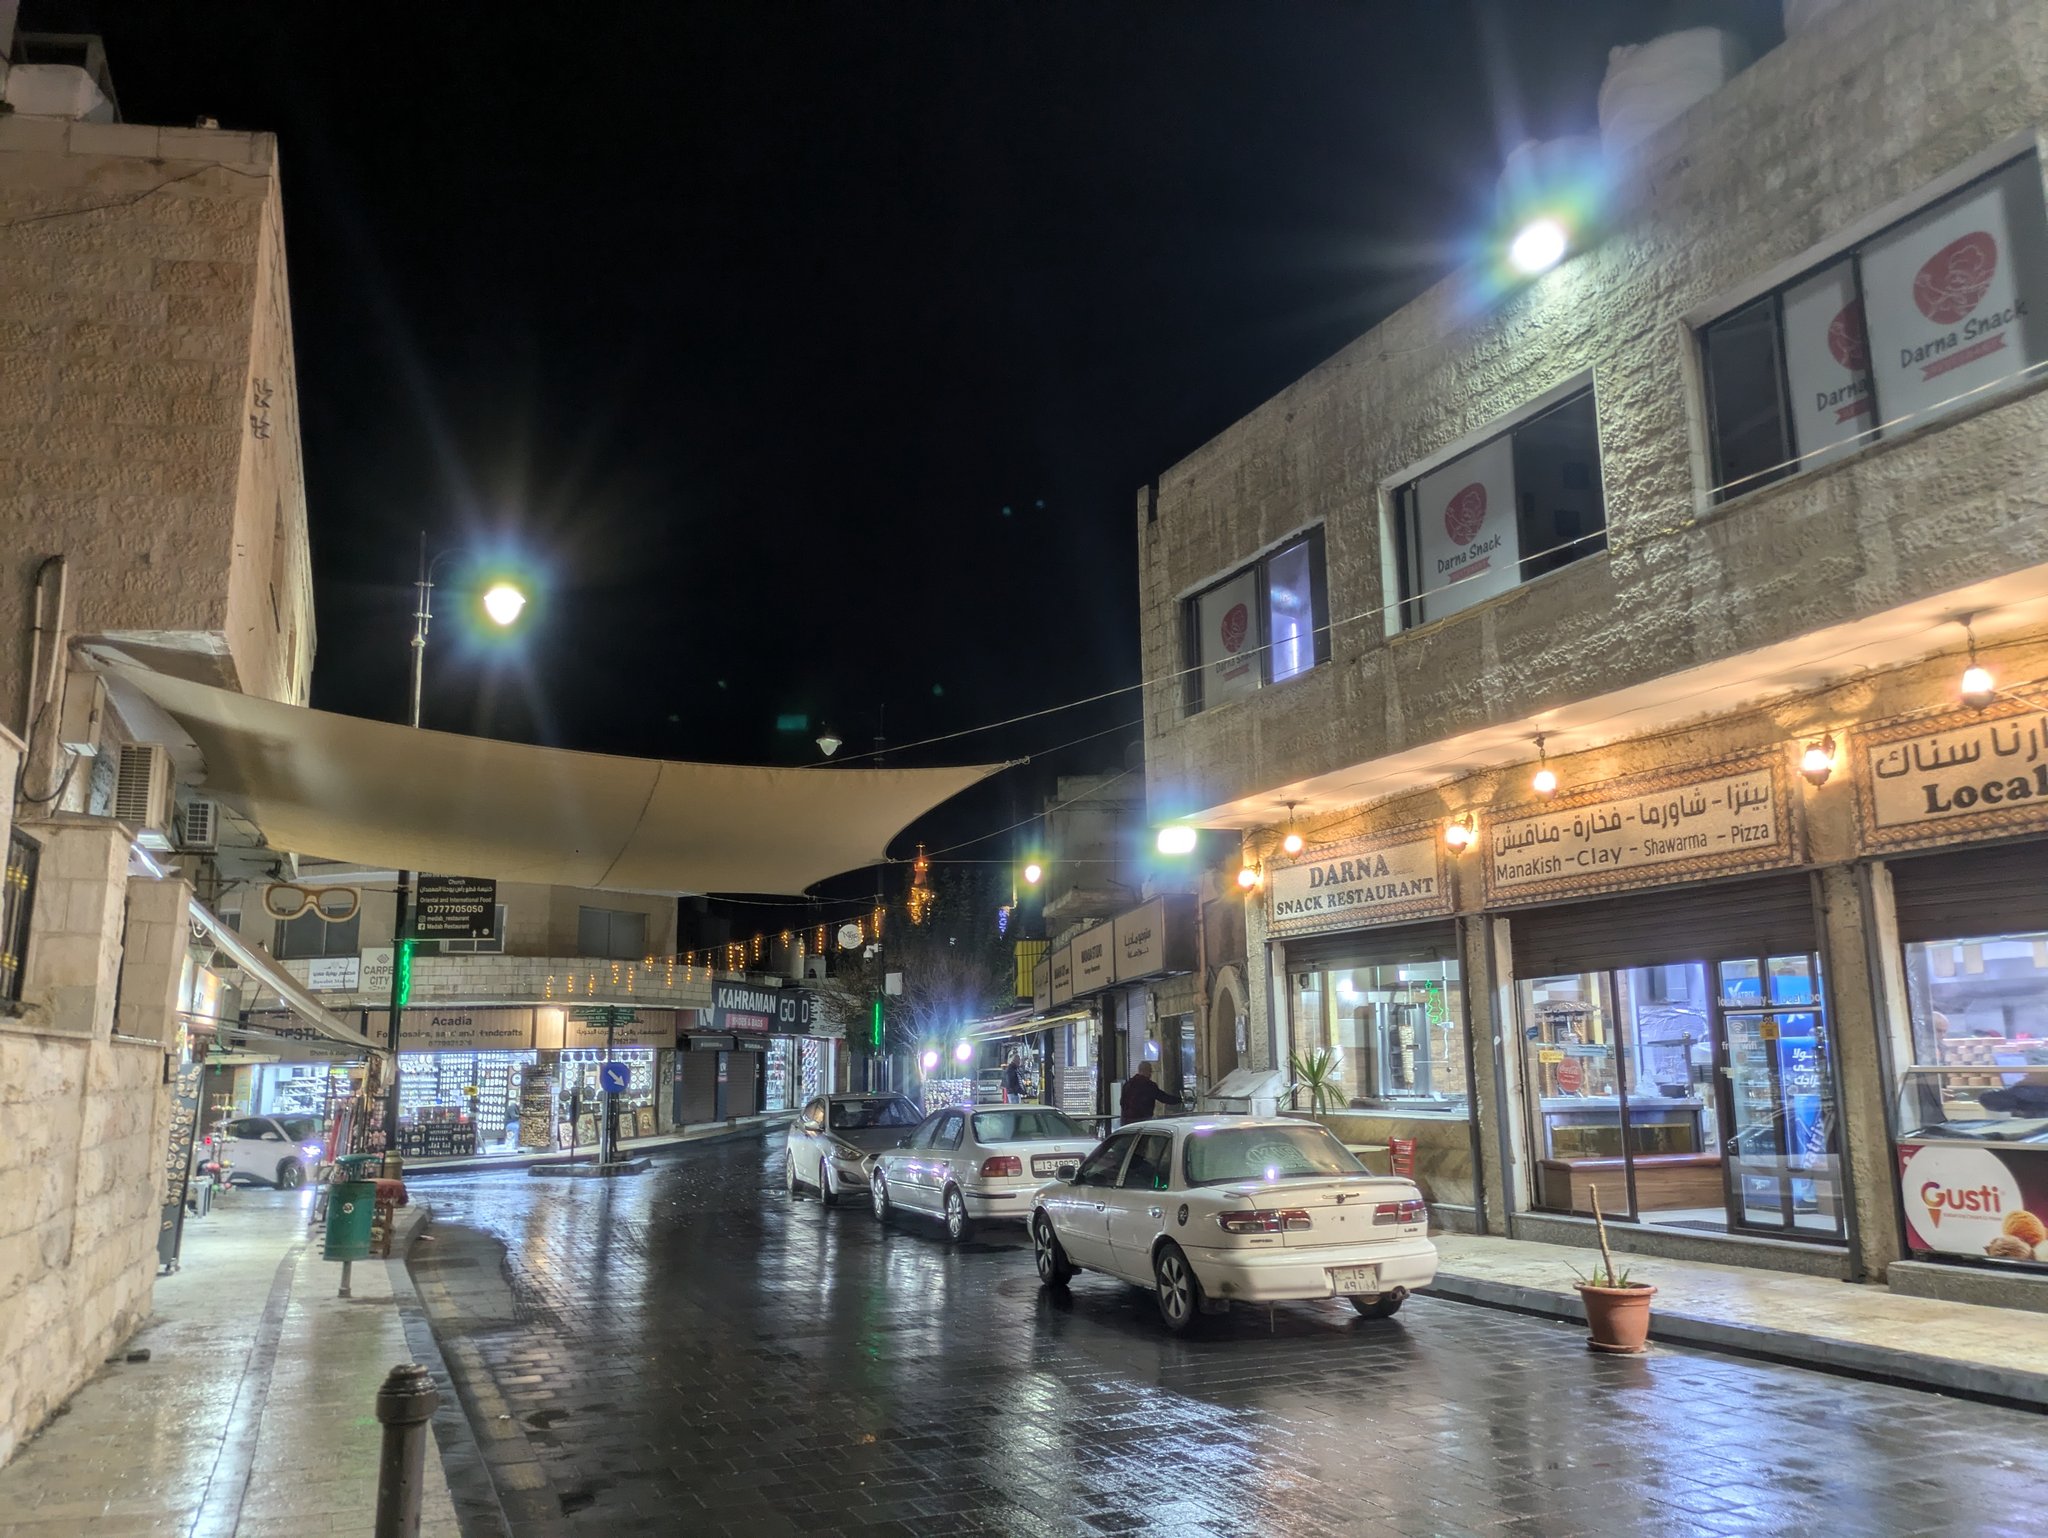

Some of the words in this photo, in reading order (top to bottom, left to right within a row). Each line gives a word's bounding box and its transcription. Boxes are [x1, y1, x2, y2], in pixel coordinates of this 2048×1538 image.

[1901, 332, 1958, 369] Darna
[1964, 300, 2028, 340] Snack
[1437, 552, 1466, 573] Darna
[1469, 534, 1501, 560] Snack
[1991, 716, 2048, 763] ارنا
[1875, 739, 1981, 779] سناك
[1727, 781, 1769, 816] بيتزا
[1922, 764, 2048, 814] Local
[1574, 806, 1622, 839] فخارة
[1639, 787, 1707, 830] شاورما
[1494, 822, 1560, 857] مناقيش
[1496, 855, 1562, 882] ManaKish
[1577, 845, 1622, 867] Clay
[1644, 831, 1708, 857] Shawarma
[1731, 823, 1769, 844] Pizza
[1309, 854, 1390, 889] DARNA
[427, 905, 484, 913] 0777705050
[1276, 895, 1323, 916] SNACK
[1327, 877, 1434, 908] RESTAURANT
[363, 966, 394, 975] CARPE
[370, 976, 390, 985] CITY
[718, 988, 776, 1014] KAHRAMAN
[780, 999, 809, 1023] GOD
[431, 1017, 473, 1026] Acadia
[751, 1018, 763, 1028] BAGS
[1921, 1181, 2001, 1213] Gusti
